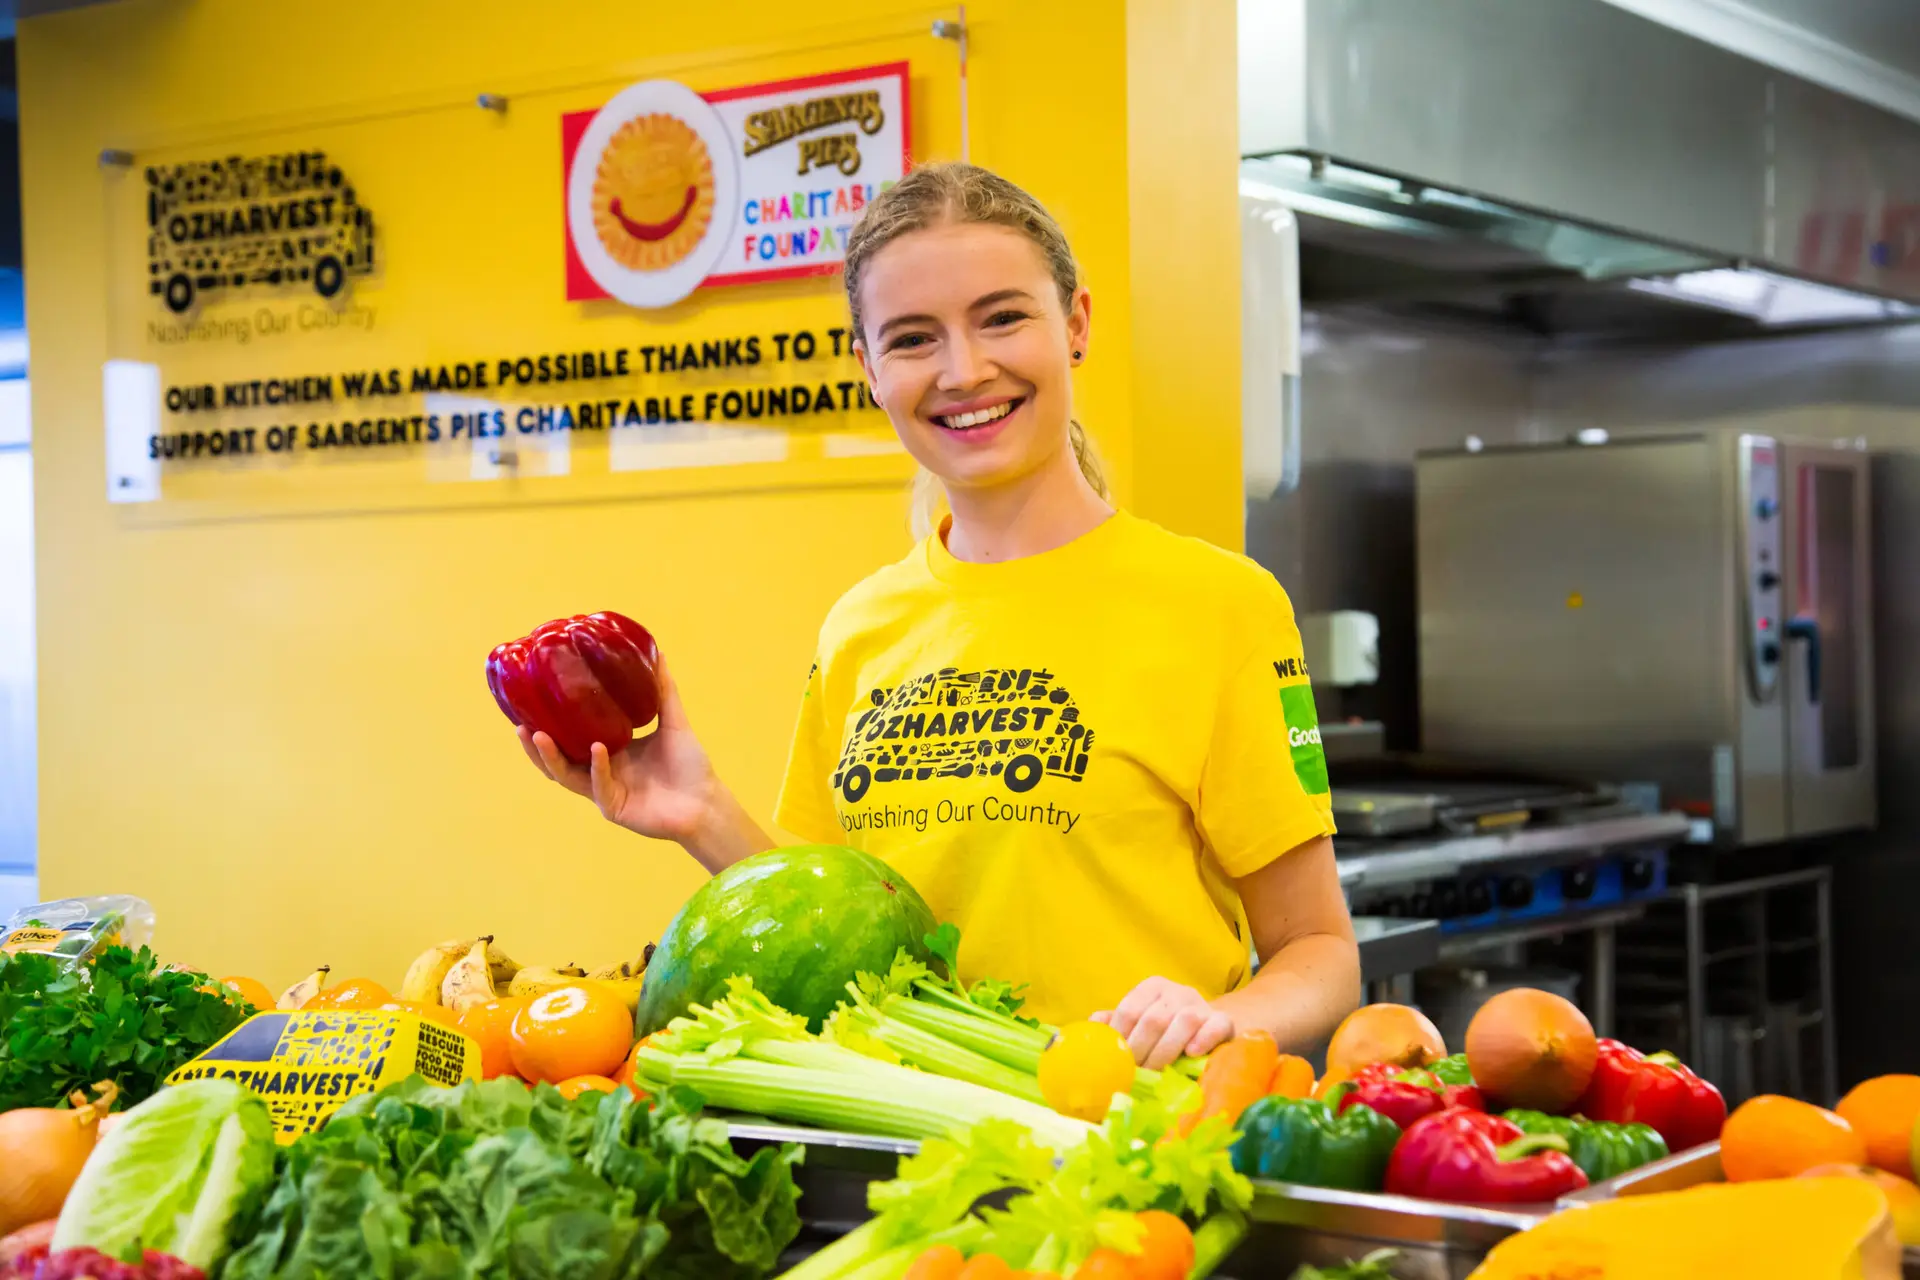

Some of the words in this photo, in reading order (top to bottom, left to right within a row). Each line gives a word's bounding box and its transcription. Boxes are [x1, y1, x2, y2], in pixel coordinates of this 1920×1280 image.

[744, 90, 884, 157] SARGENTS
[797, 133, 861, 176] PIES
[168, 197, 336, 243] OZHARVEST
[744, 226, 850, 262] FOUNDAT
[255, 307, 288, 336] Our
[166, 386, 216, 412] OUR
[224, 376, 332, 407] KITCHEN
[341, 370, 400, 397] WAS
[409, 361, 488, 393] MADE
[497, 350, 630, 386] POSSIBLE
[640, 336, 762, 373] THANKS
[772, 330, 816, 361] TO
[149, 429, 255, 459] SUPPORT
[266, 425, 298, 452] OF
[306, 414, 440, 448] SARGENTS
[450, 409, 505, 440] PIES
[516, 393, 694, 434] CHARITABLE
[1273, 658, 1297, 679] WE
[865, 707, 1054, 743] OZHARVEST
[936, 799, 975, 824] Our
[982, 796, 1081, 834] Country
[417, 1050, 442, 1066] FOOD
[444, 1060, 463, 1073] AND
[418, 1030, 465, 1058] RESCUES
